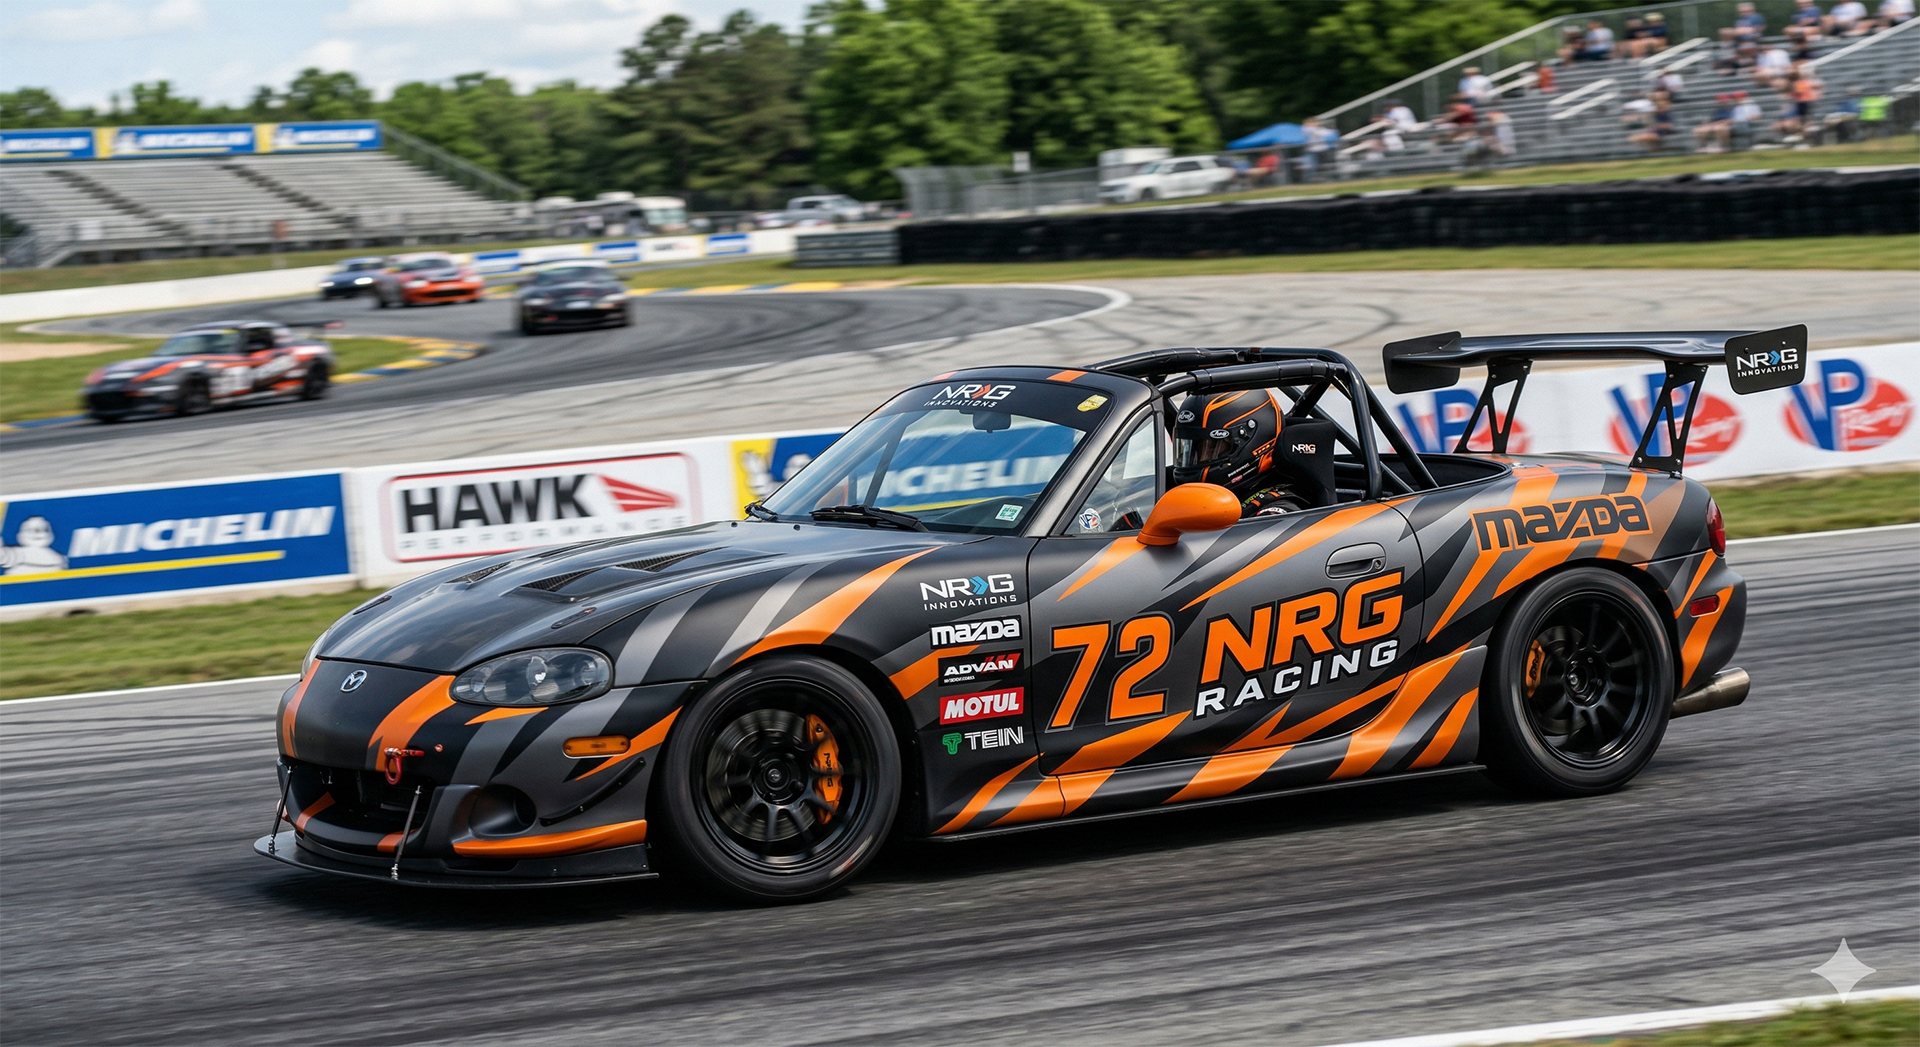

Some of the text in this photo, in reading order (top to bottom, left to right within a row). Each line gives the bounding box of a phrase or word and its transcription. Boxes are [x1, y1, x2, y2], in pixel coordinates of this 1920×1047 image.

[1737, 363, 1800, 378] INNOVATIONS
[923, 399, 998, 409] INNOVATIONS
[401, 474, 592, 533] HAWK
[67, 505, 336, 558] MICHELIN
[924, 594, 1017, 611] INNOVATIONS
[1201, 571, 1404, 684] NRG
[944, 659, 1014, 676] ADVAN
[1051, 615, 1172, 728] 72
[1196, 639, 1398, 717] RACING
[944, 692, 1019, 719] MOTUL
[964, 726, 1024, 750] TEIN
